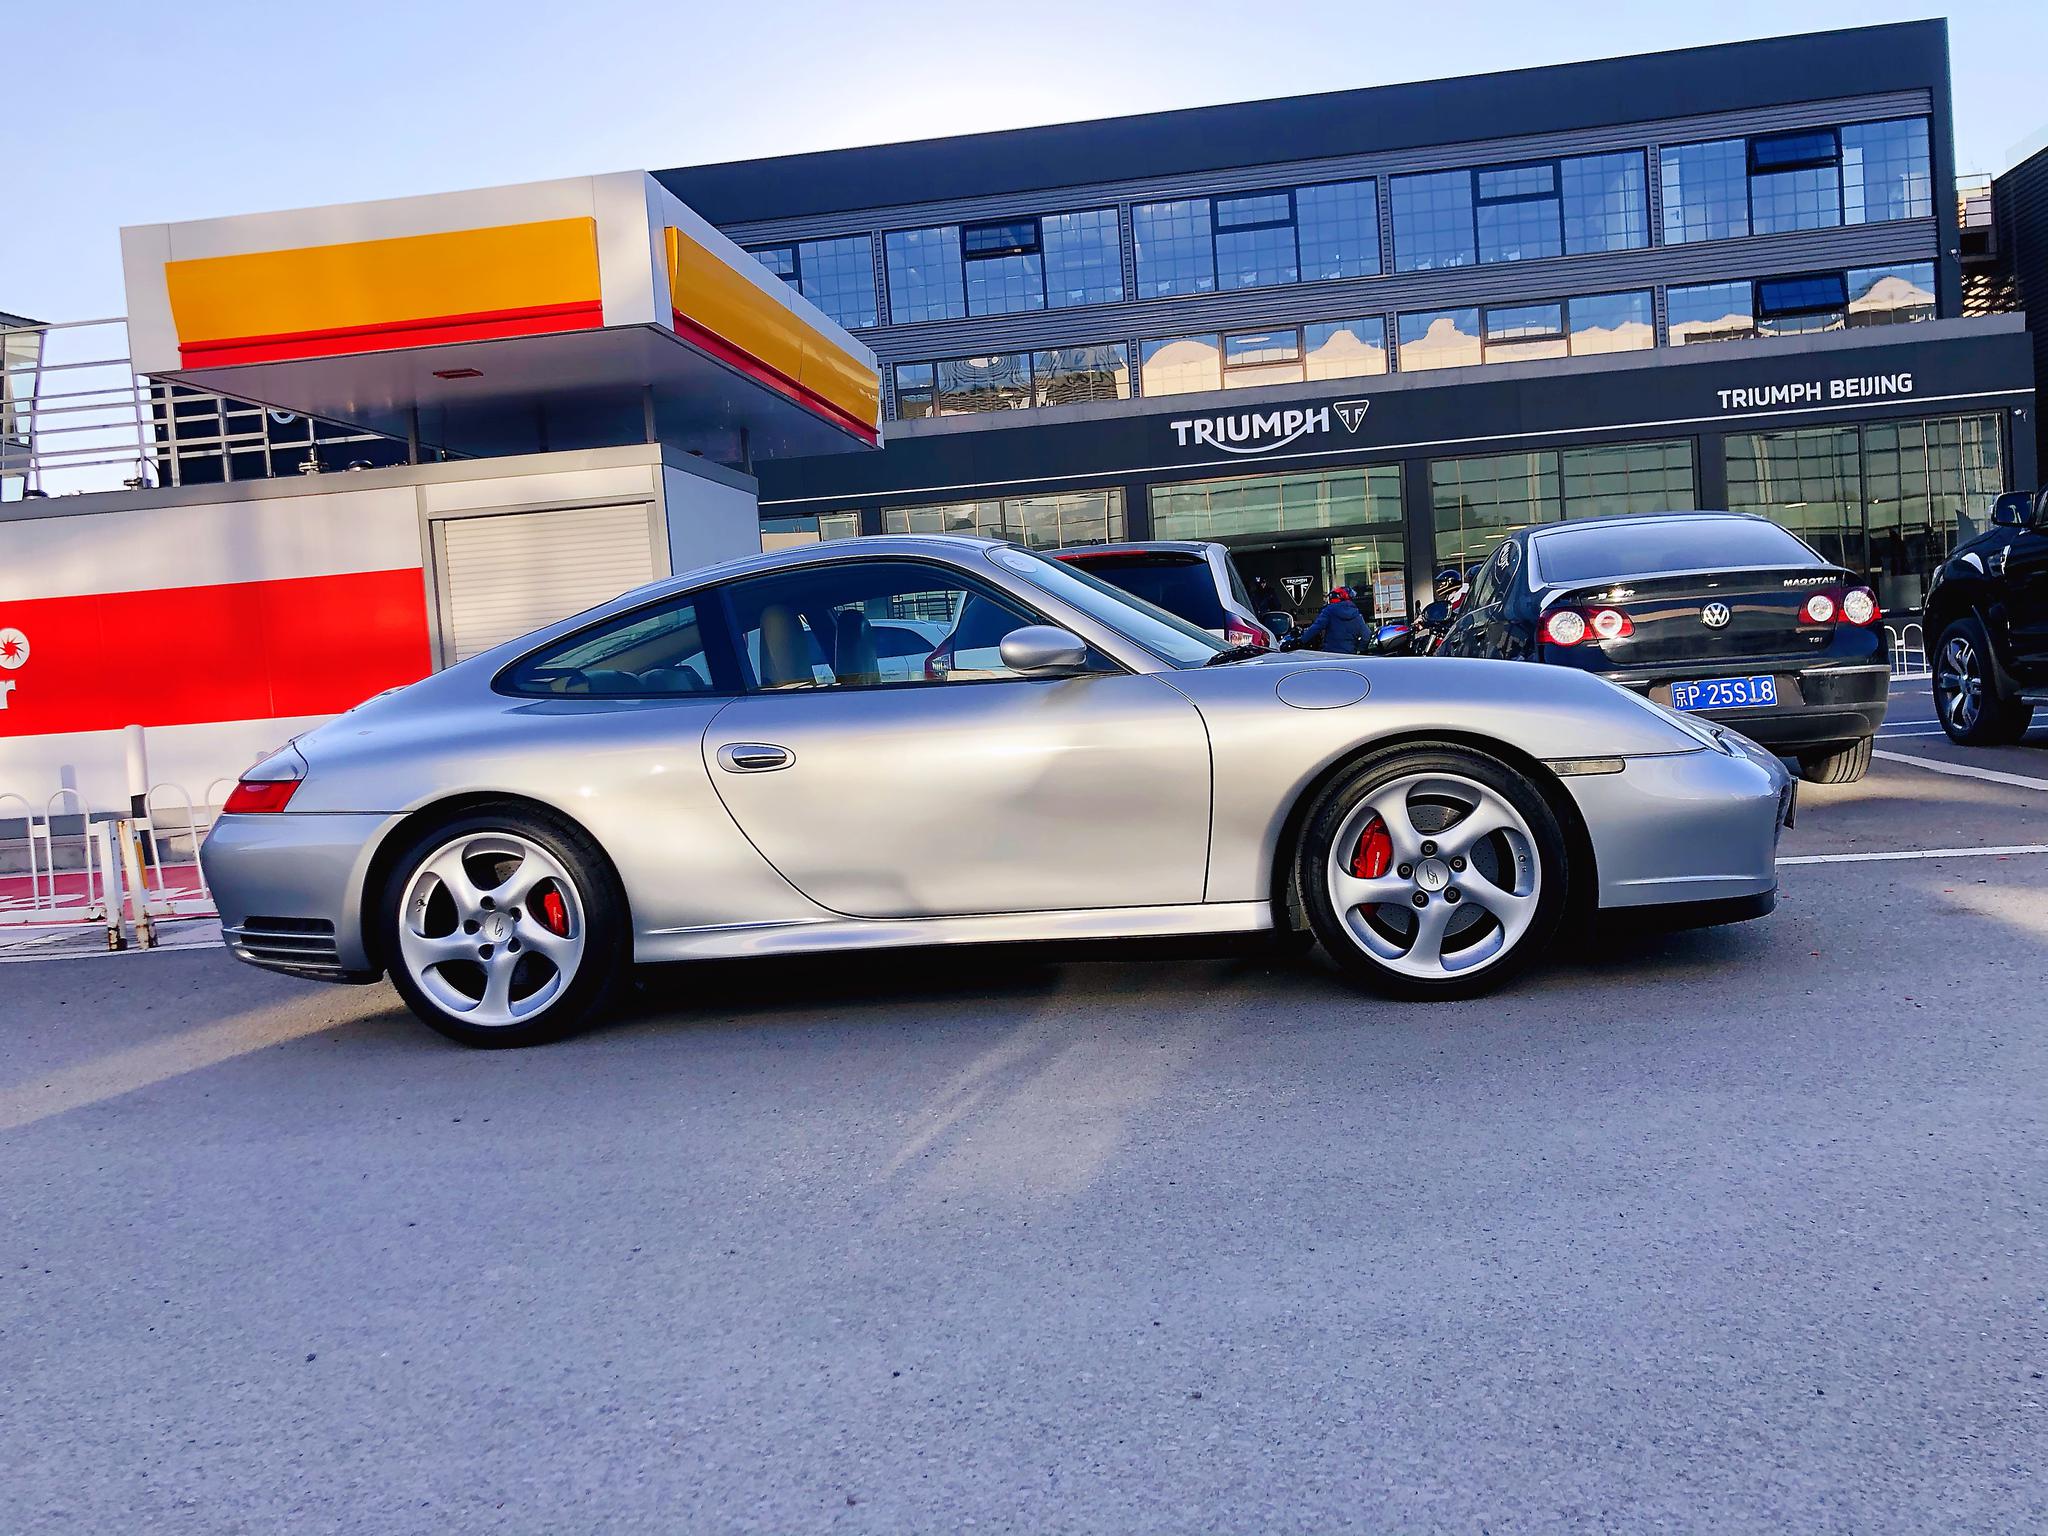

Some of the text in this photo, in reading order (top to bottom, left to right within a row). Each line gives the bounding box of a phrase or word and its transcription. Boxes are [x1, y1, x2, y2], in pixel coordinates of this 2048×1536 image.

[1717, 373, 1912, 409] TRIUMPH BEIJING
[1170, 406, 1330, 453] TRIUMPH
[1783, 575, 1837, 587] MAGOTAN
